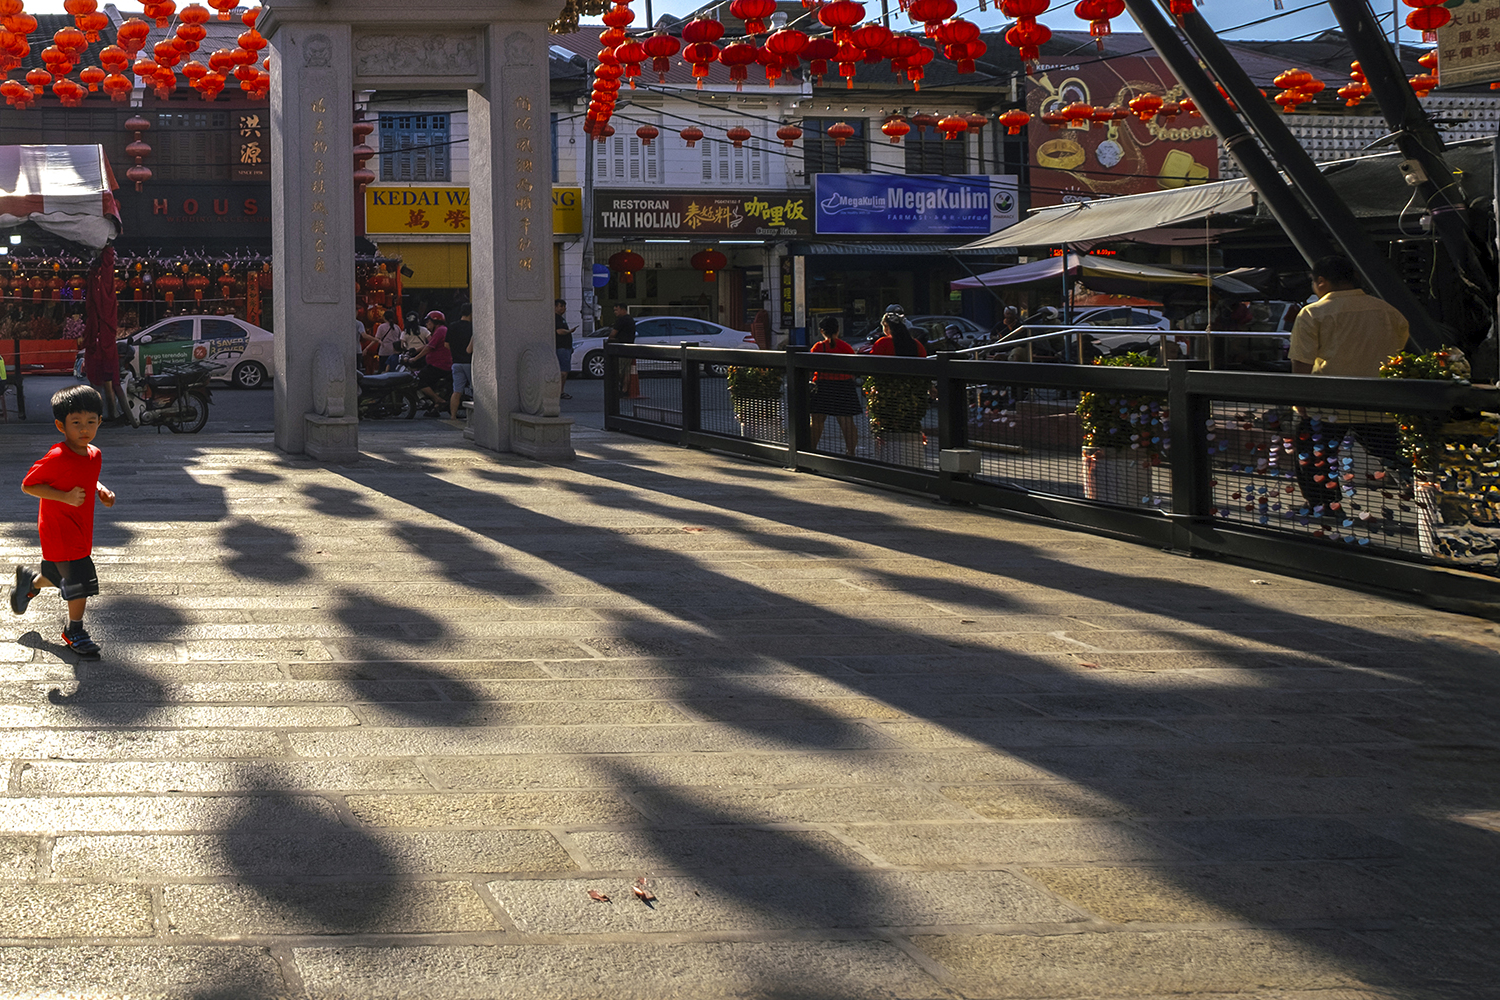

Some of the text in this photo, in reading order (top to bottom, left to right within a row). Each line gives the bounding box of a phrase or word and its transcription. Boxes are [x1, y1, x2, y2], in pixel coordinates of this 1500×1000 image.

[239, 114, 262, 166] 洪源
[373, 191, 440, 206] KEDAI
[613, 199, 669, 210] RESTORAN
[840, 195, 886, 208] MegaKulim
[887, 186, 989, 214] MegaKulim
[601, 212, 681, 229] THAI HOLIAU
[755, 227, 798, 236] Curry Rice
